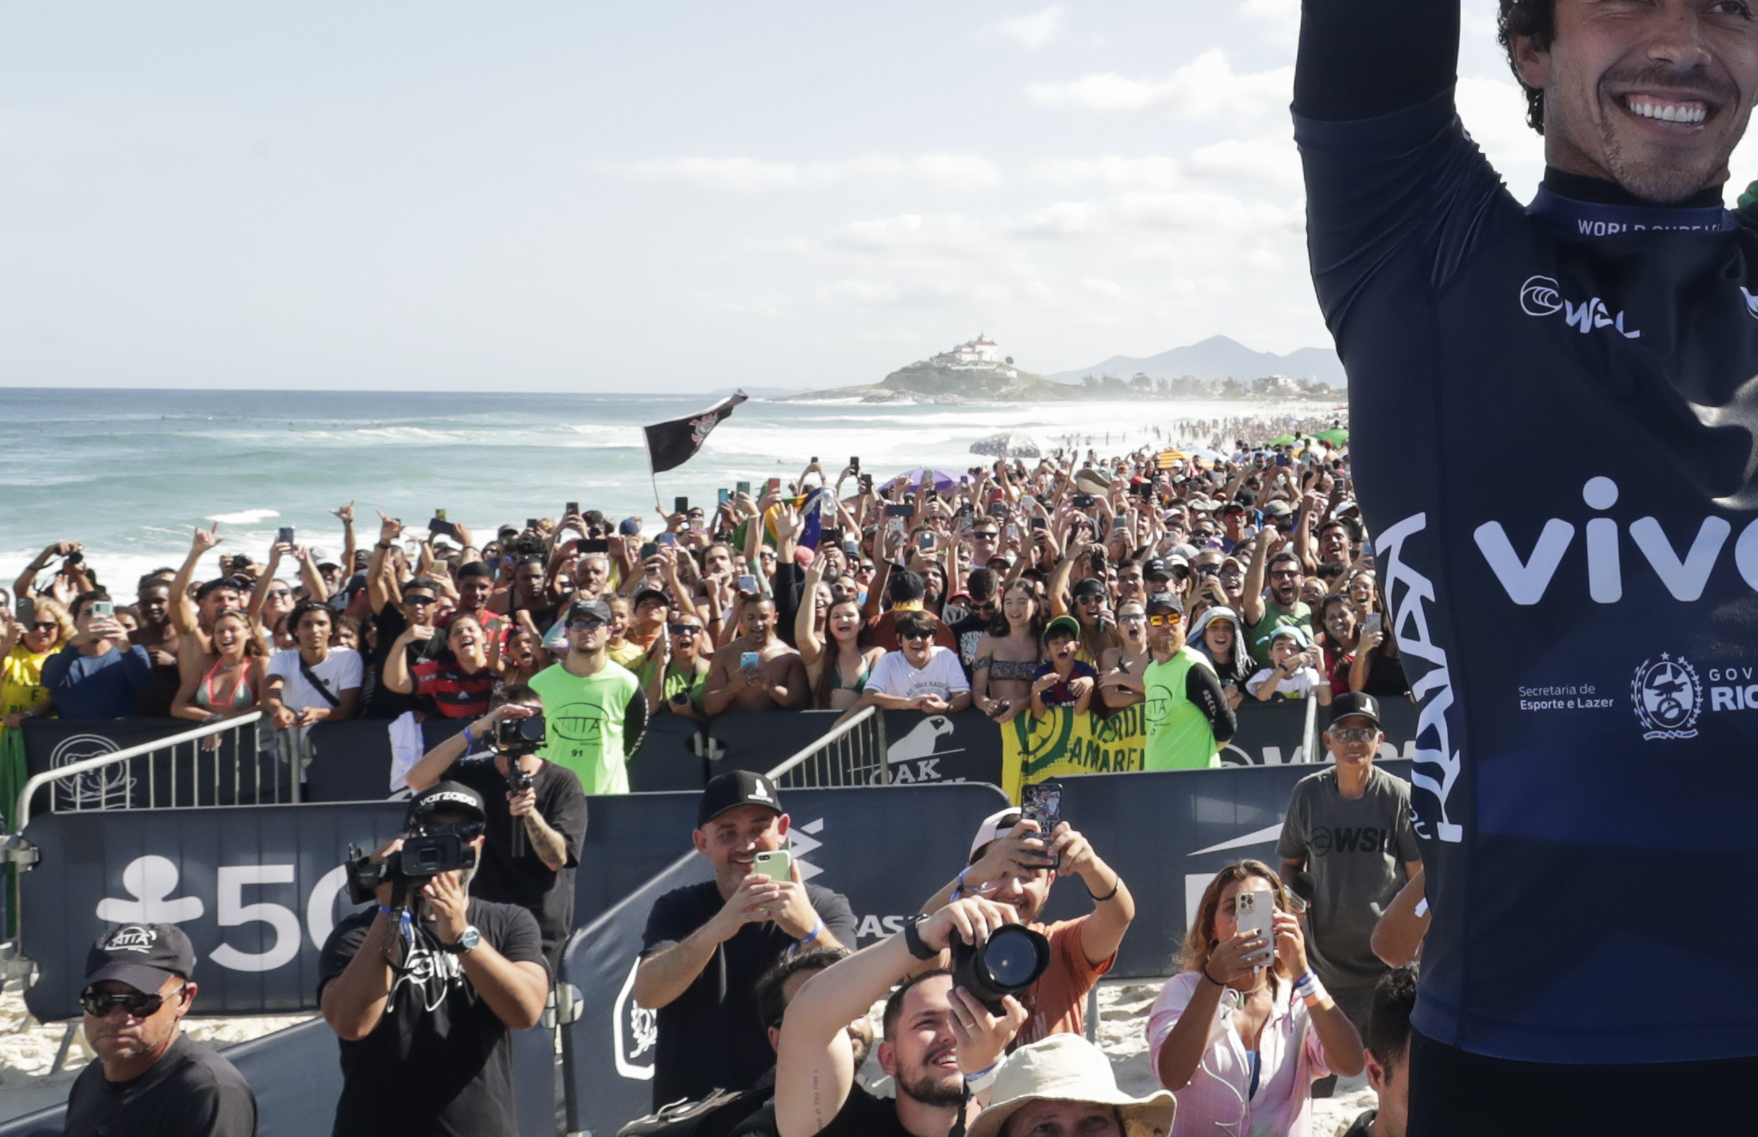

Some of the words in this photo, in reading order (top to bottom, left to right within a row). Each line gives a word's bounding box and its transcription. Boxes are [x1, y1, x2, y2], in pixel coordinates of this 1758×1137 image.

[1518, 685, 1578, 697] Secretaria
[1580, 684, 1596, 696] de
[1520, 698, 1564, 711] Esporte
[1566, 700, 1576, 710] e
[1577, 696, 1614, 710] Lazer
[571, 749, 583, 757] 91
